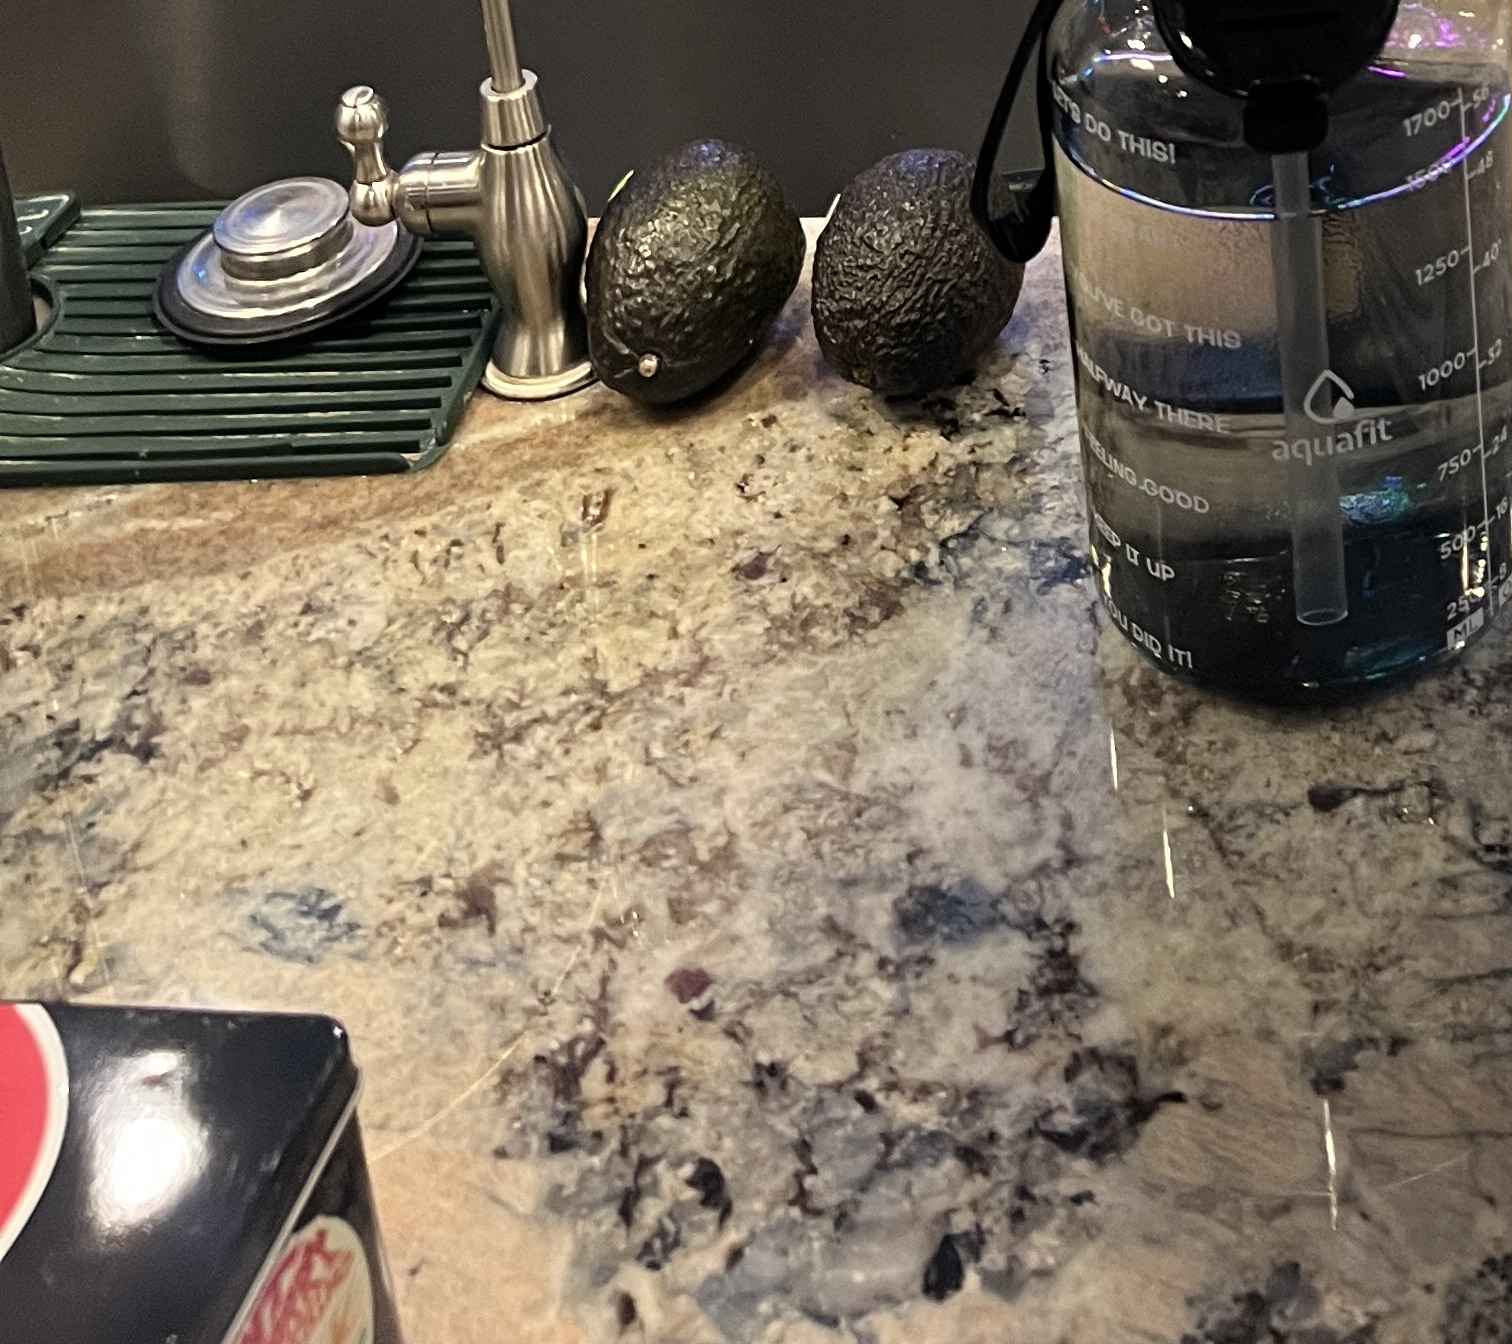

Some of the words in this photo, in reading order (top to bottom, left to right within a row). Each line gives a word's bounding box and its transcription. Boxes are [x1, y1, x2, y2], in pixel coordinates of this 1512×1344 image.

[1401, 100, 1450, 137] 1700
[1084, 111, 1113, 143] DO
[1116, 128, 1177, 166] THIS!
[1414, 249, 1460, 288] 1250
[1129, 305, 1177, 338] GOT
[1183, 322, 1243, 350] THIS
[1417, 351, 1467, 392] 1000
[1153, 399, 1233, 435] THERE
[1270, 415, 1394, 467] aquafit
[1436, 447, 1473, 483] 750
[1142, 477, 1211, 515] GOOD
[1439, 524, 1477, 561] 500
[1145, 556, 1177, 582] UP
[1131, 621, 1163, 660] DID
